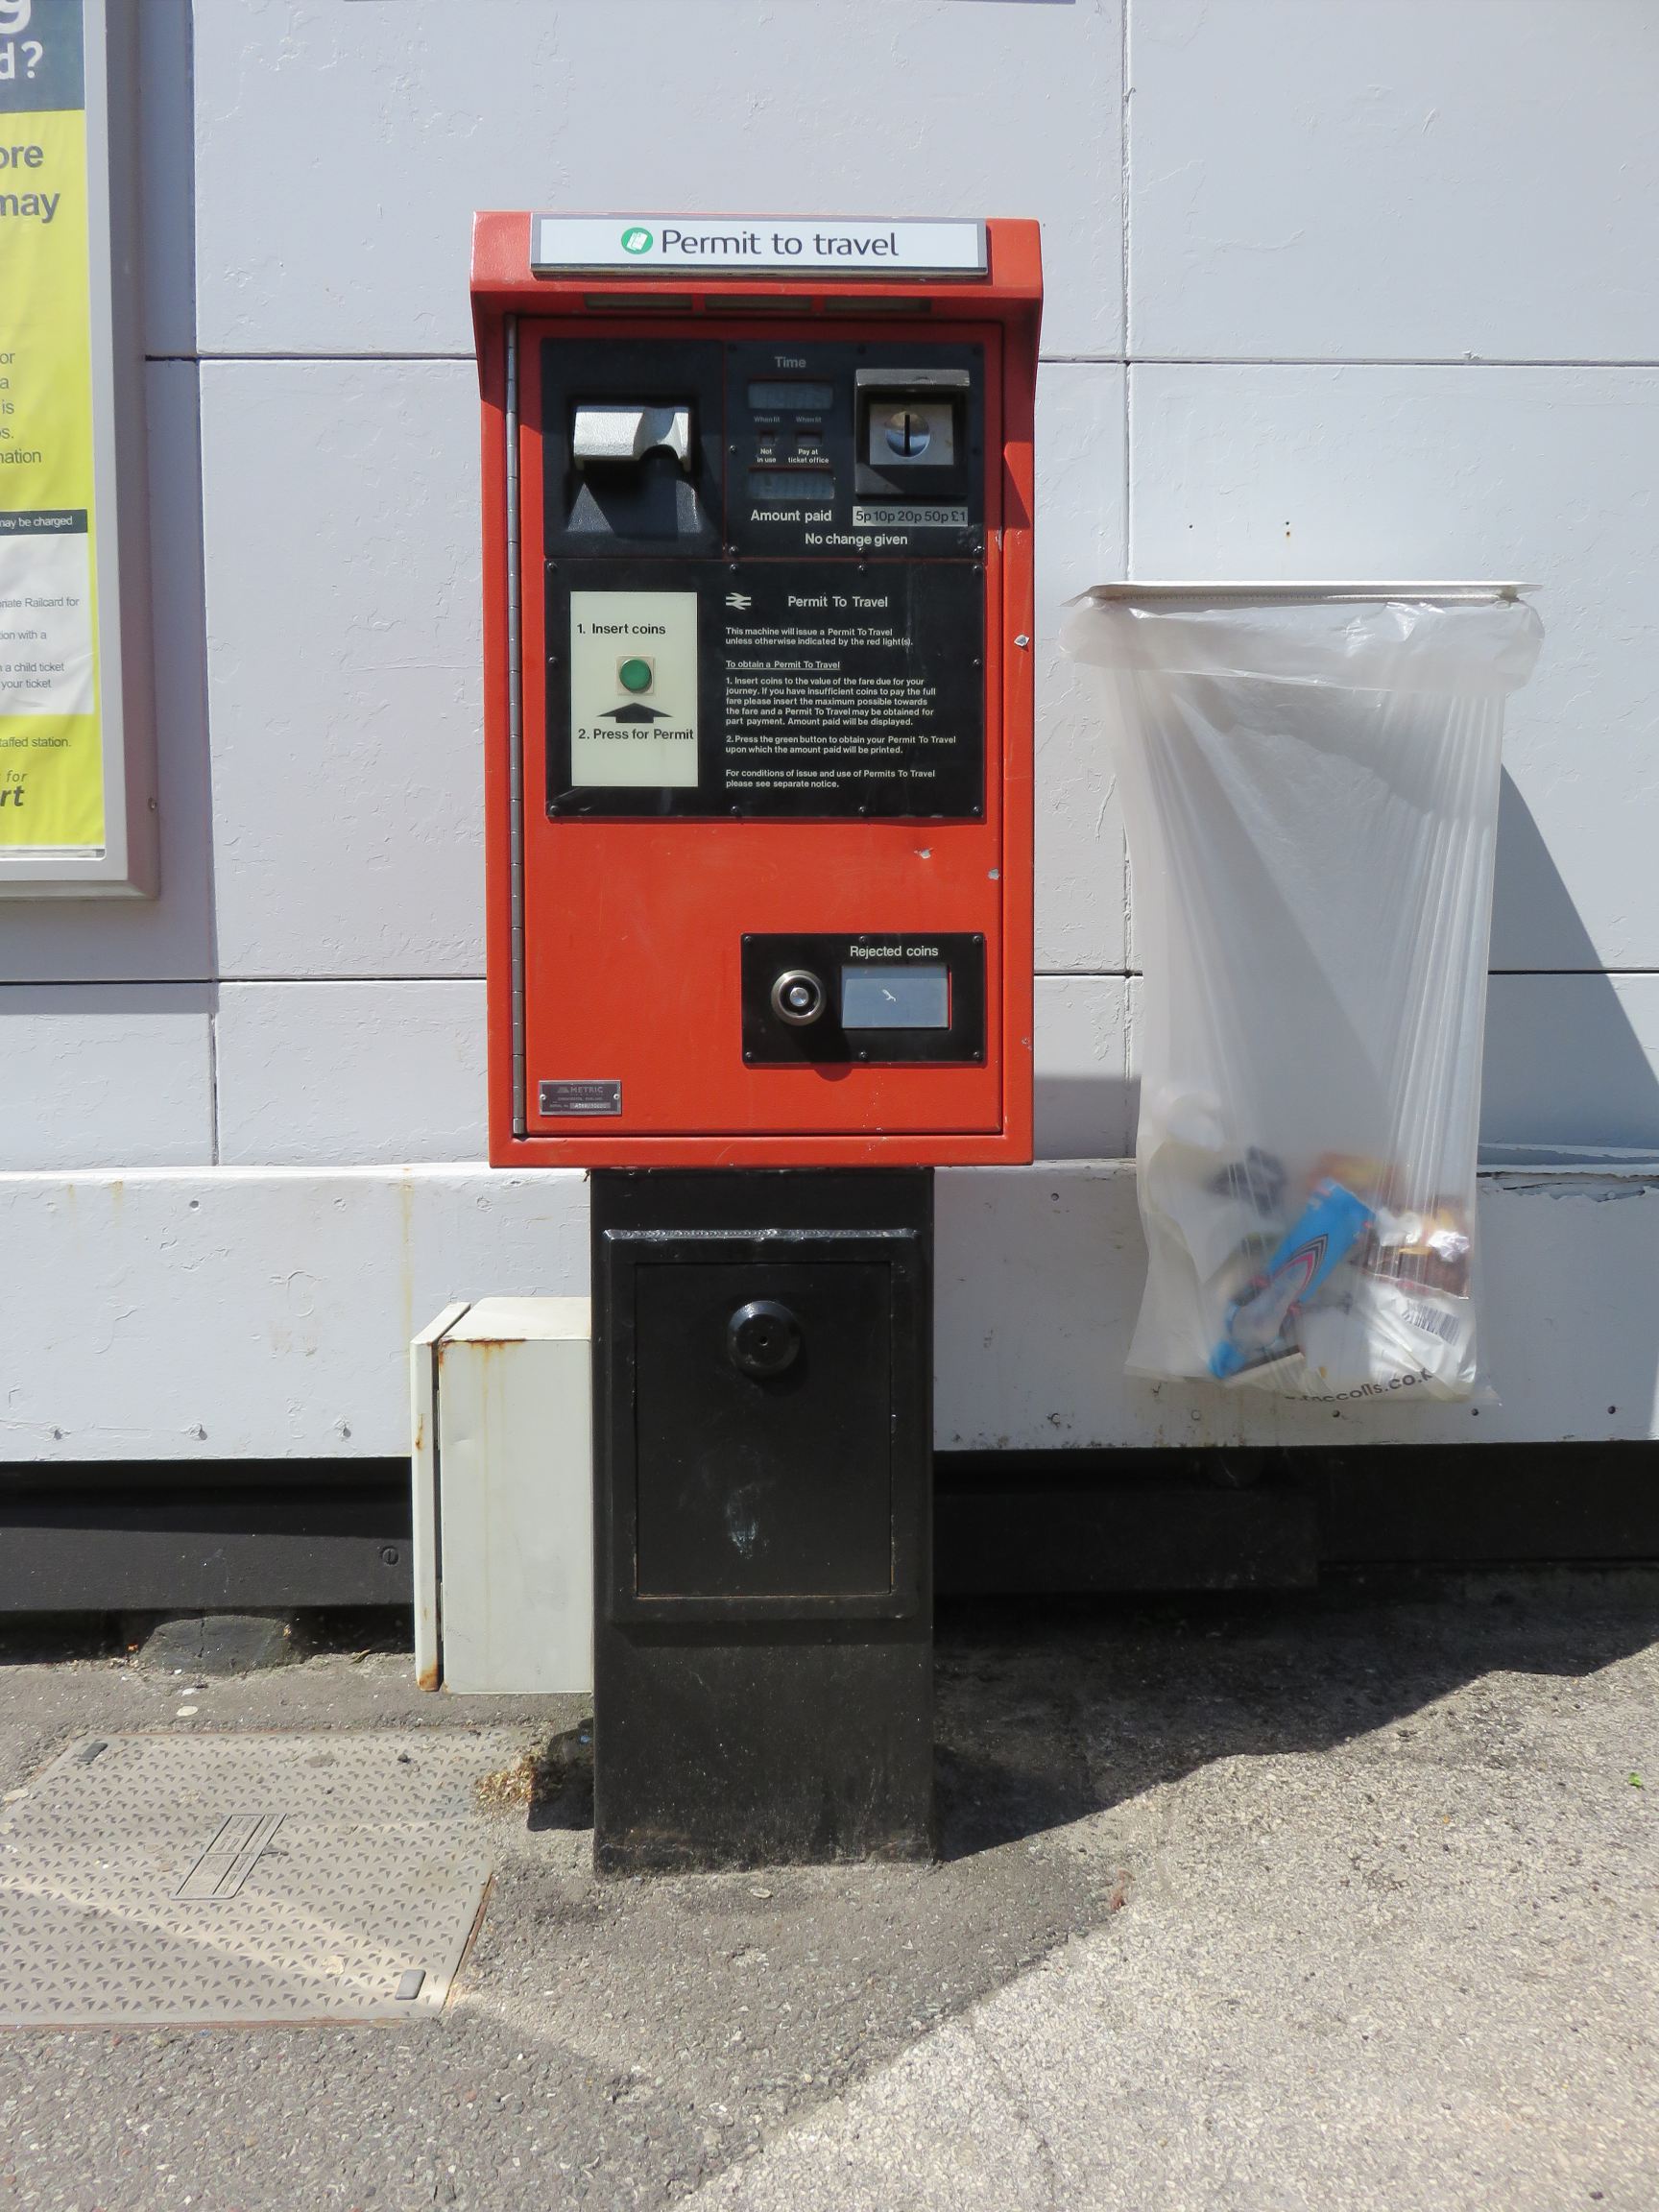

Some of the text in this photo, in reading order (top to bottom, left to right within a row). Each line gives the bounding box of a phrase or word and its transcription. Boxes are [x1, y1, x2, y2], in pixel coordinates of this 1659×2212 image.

[662, 229, 899, 256] Permit to travel
[775, 356, 806, 368] Time
[2, 398, 15, 415] is
[18, 516, 73, 528] be charged
[751, 510, 832, 524] Amount paid
[855, 510, 966, 523] 5p 10p 20p 50p £1
[805, 533, 907, 547] No change given
[25, 595, 80, 608] Railcard for
[788, 596, 888, 608] Permit To Travel
[577, 623, 666, 634] 1. Insert coins
[726, 628, 892, 637] This machine will issue Permit To Travel
[17, 629, 37, 640] with
[726, 637, 913, 646] unless otherwise indicated by the red light(s).
[13, 661, 65, 673] child ticket
[726, 661, 840, 669] To obtain Permit To Travel
[1, 678, 52, 691] your ticket
[727, 677, 925, 685] 1. Insert coins to the value of the fare due for your
[726, 687, 936, 696] journey. If you have insufficient coins to pay the full
[726, 697, 927, 706] fare please insert the maximum possible towards
[726, 708, 933, 716] the fare and a Permit To Travel may be obtained for
[726, 718, 913, 727] part payment. Amount paid will be displayed.
[579, 729, 694, 740] 2. Press for Permit
[727, 735, 956, 744] 2. Press the green button to obtain your Permit To Travel
[31, 737, 72, 747] station.
[726, 746, 902, 755] upon which the amount paid will be printed.
[6, 770, 28, 783] for
[726, 780, 839, 788] please see separate notice.
[850, 946, 939, 959] Rejected coins
